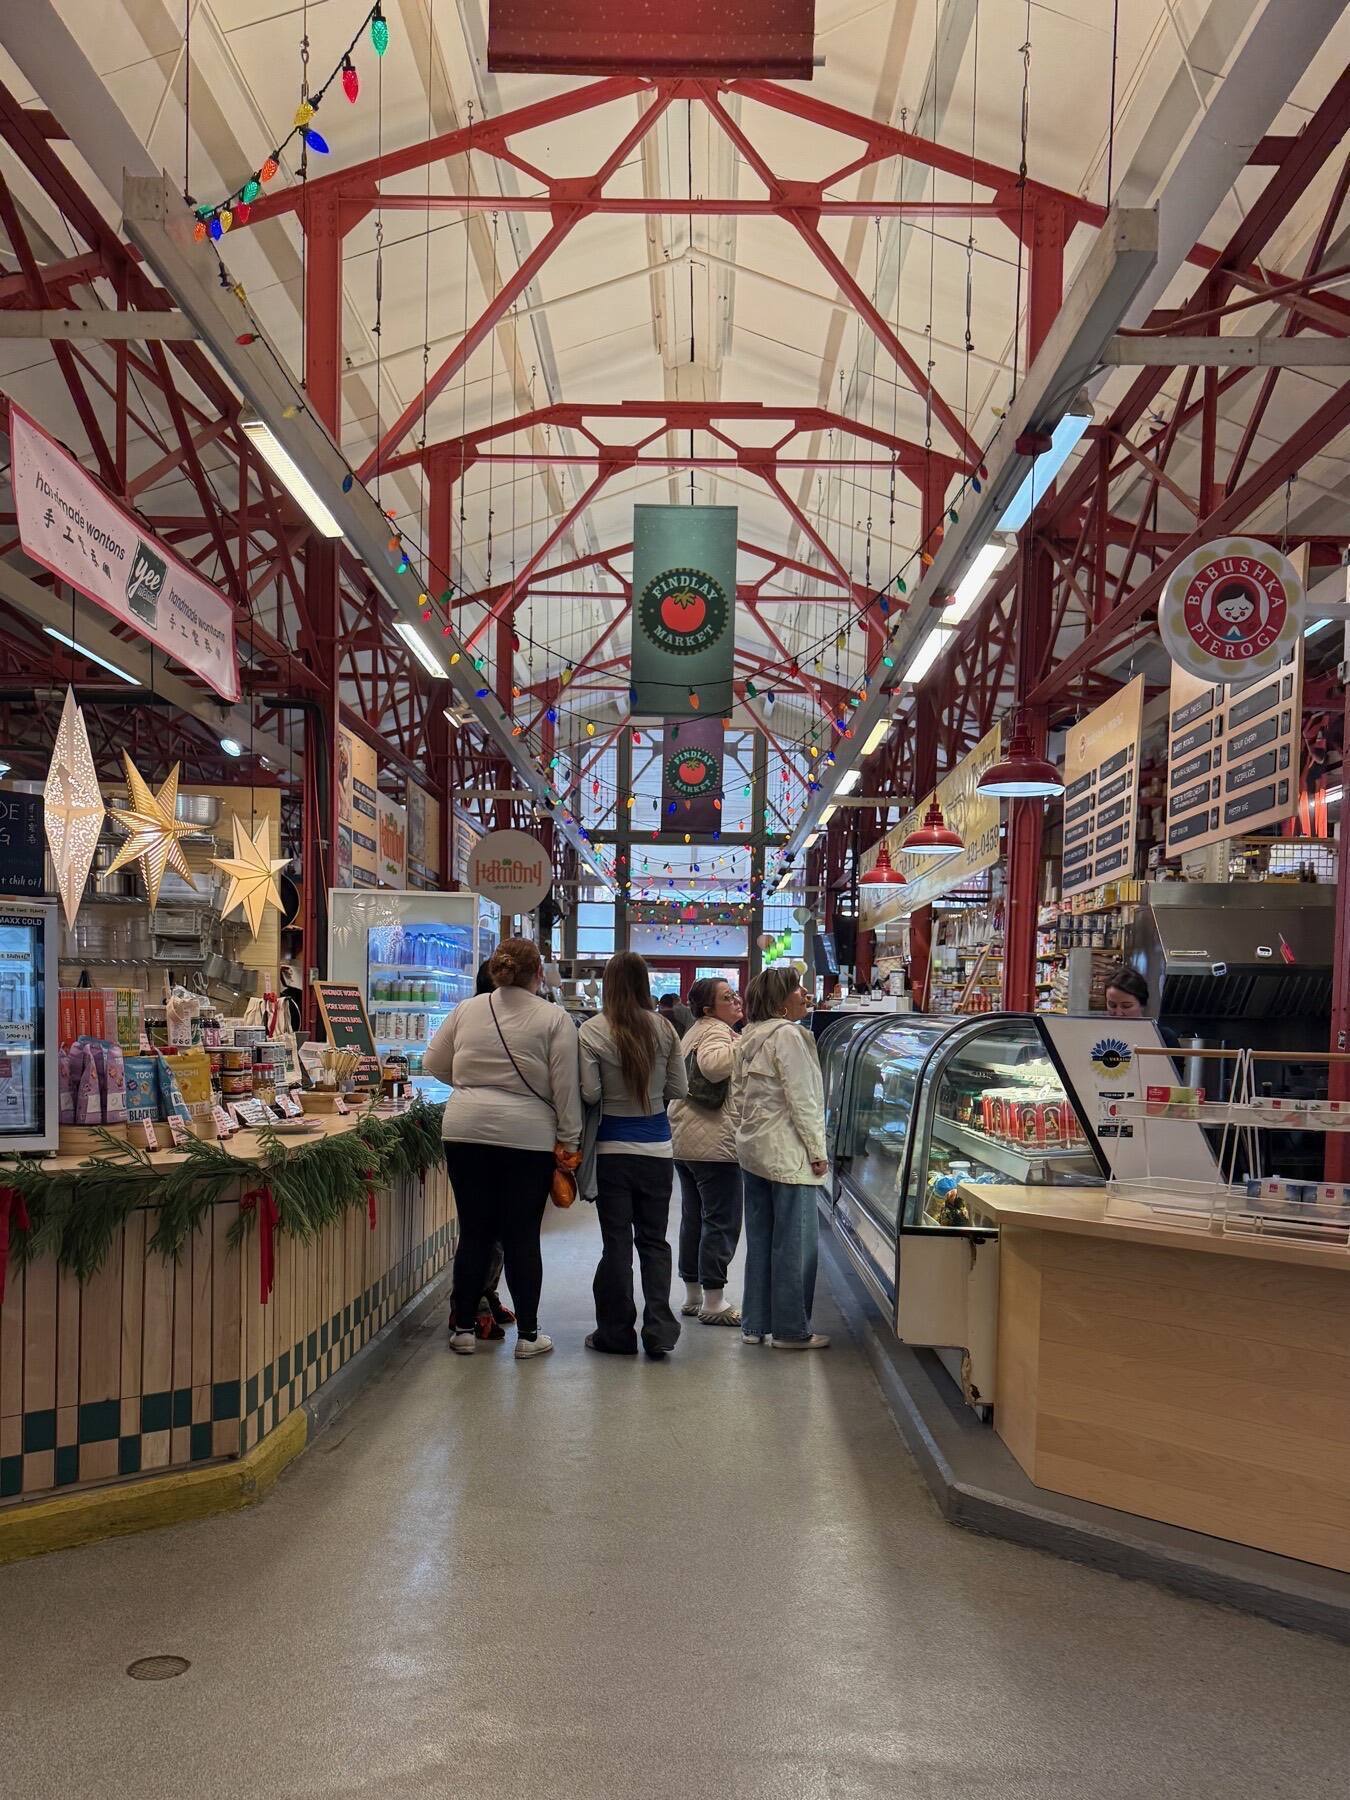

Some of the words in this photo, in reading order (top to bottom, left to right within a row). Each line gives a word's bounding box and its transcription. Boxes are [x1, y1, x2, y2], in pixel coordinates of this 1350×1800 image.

[86, 521, 126, 560] wontons
[128, 556, 161, 599] yee
[652, 575, 719, 600] FINDLAY
[1187, 559, 1284, 608] BABUSHKA
[652, 623, 715, 647] MARKET
[1190, 621, 1279, 658] PIEROGI
[673, 748, 714, 766] FINDLAY
[673, 778, 712, 793] MARKET
[21, 917, 42, 926] COLD
